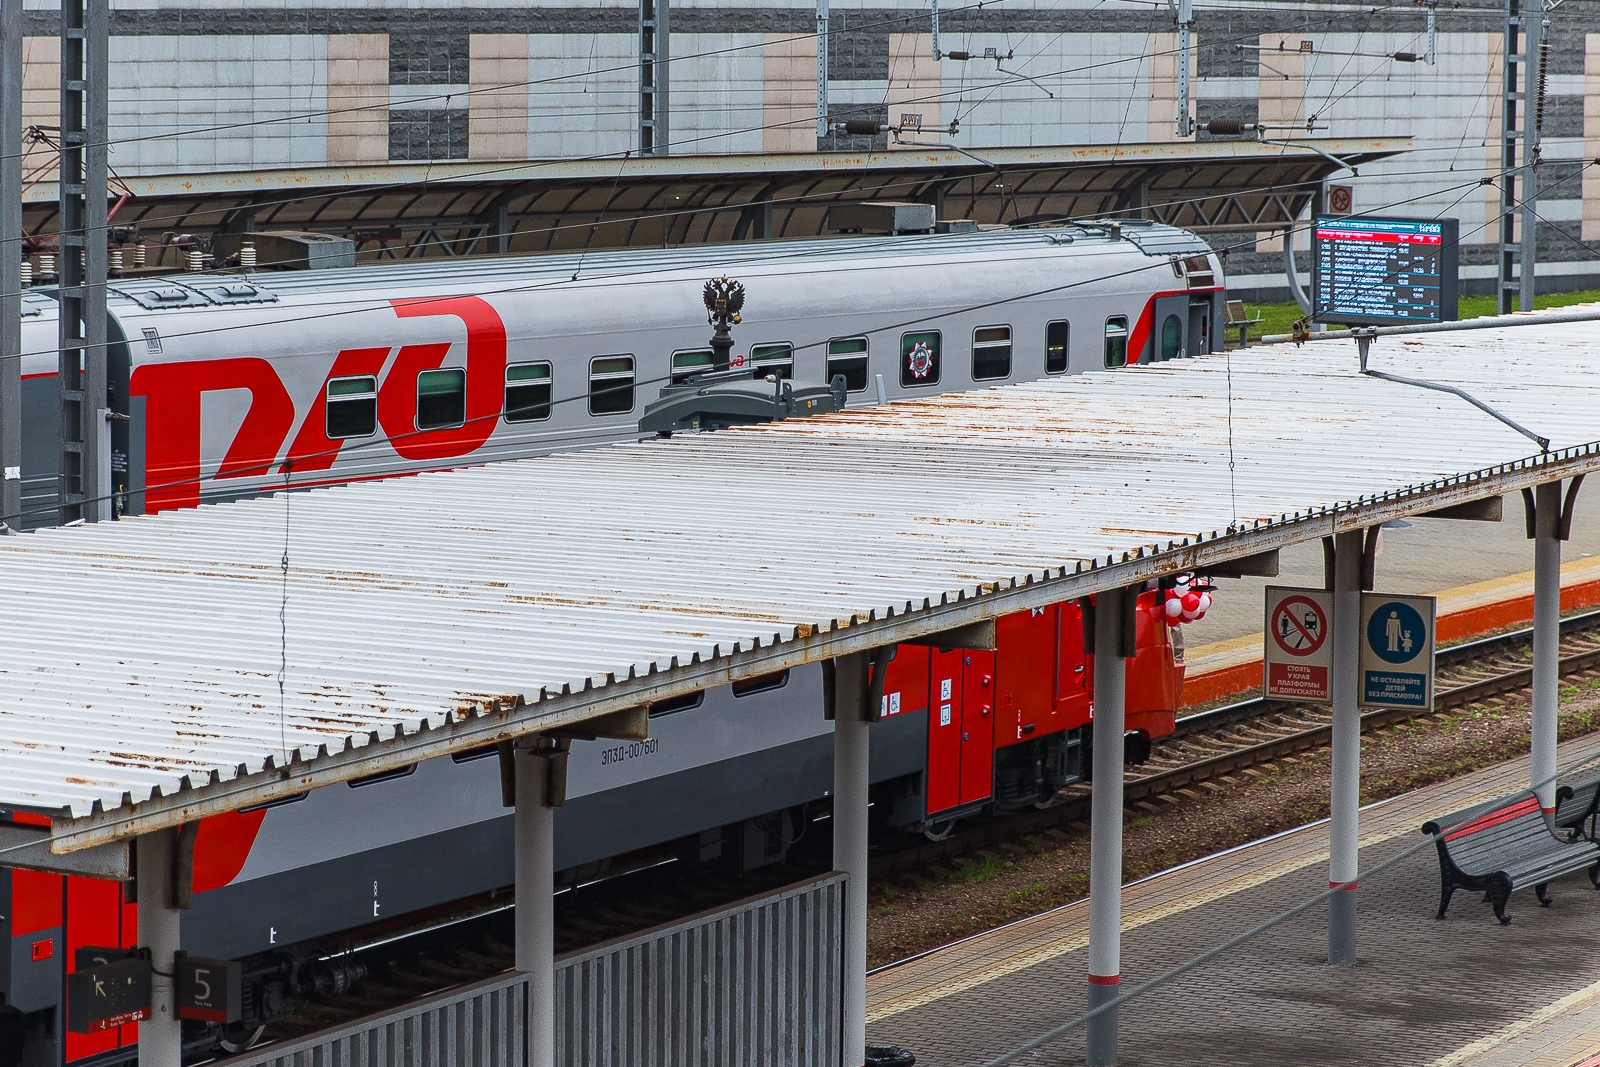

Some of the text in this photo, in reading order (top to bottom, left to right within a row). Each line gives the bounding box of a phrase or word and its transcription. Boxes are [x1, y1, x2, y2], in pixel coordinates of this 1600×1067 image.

[1287, 665, 1311, 673] СТОЯТЬ
[1277, 680, 1320, 688] ПЛАТФОРМЫ
[1380, 677, 1421, 685] ОСТАВЛЯЙТЕ
[1279, 687, 1327, 697] ДОПУСКАЕТСЯ!
[1380, 691, 1422, 700] ПРИСМОТРА!
[195, 969, 211, 1000] 5
